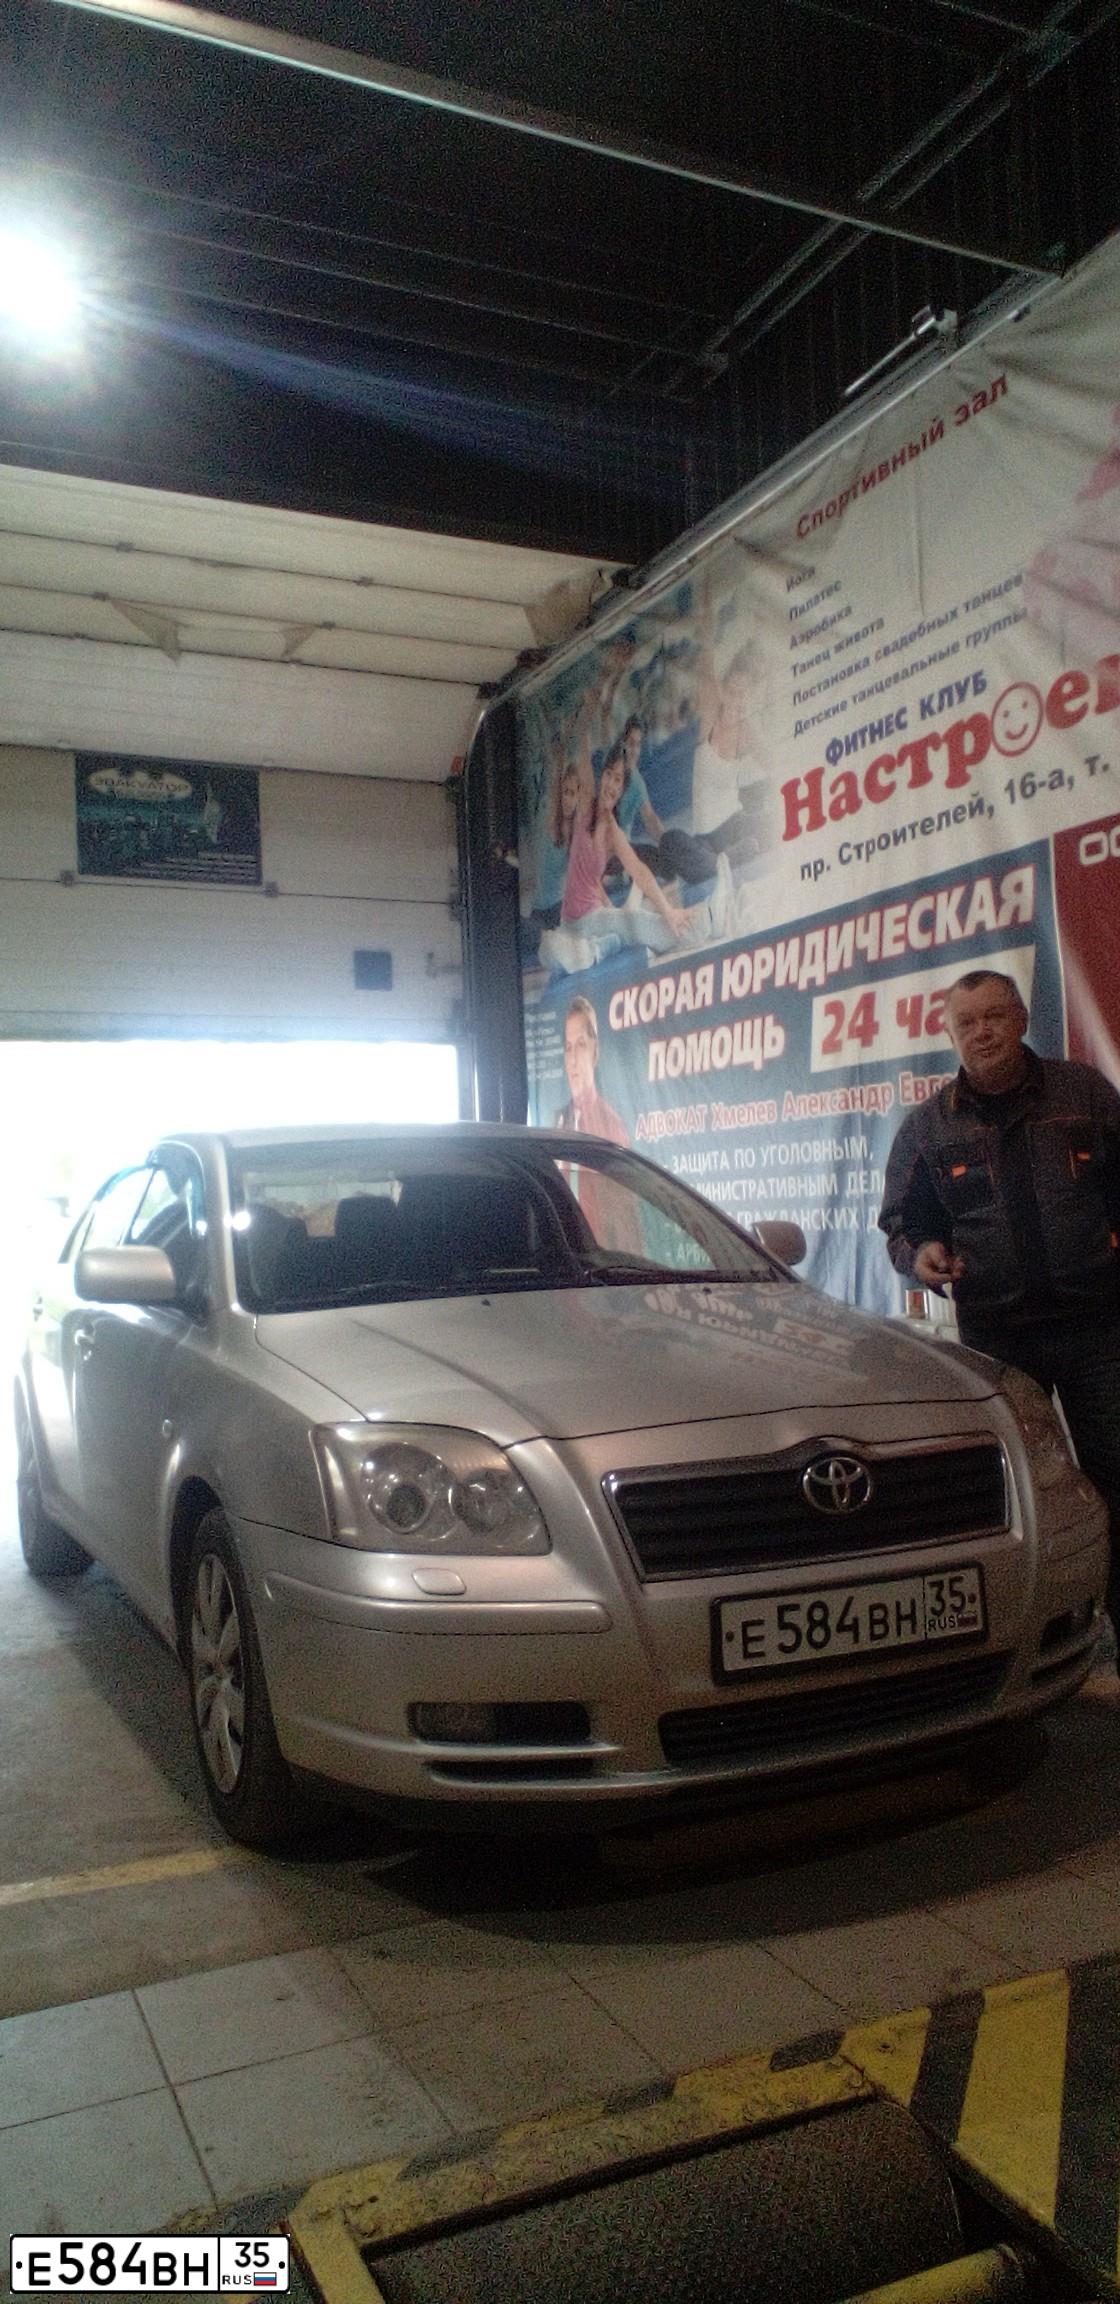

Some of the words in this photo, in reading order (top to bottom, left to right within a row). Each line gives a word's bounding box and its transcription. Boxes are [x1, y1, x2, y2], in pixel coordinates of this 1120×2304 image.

[796, 416, 946, 540] Спортивный
[954, 373, 1009, 428] зал
[789, 580, 843, 622] Пилатес
[789, 605, 852, 650] Аэробика
[791, 648, 831, 678] Танец
[834, 617, 885, 655] живота
[792, 656, 870, 707] Постановка
[874, 607, 959, 663] свадебных
[963, 572, 1024, 614] танцев
[793, 699, 848, 738] Детские
[852, 640, 960, 705] танцевальные
[965, 606, 1029, 648] группы
[825, 706, 908, 767] ФИТНЕС
[919, 669, 988, 721] КЛУБ
[800, 860, 831, 882] пр.
[838, 792, 995, 866] Строителей,
[1003, 768, 1075, 805] 16-а,
[1084, 753, 1111, 778] т.
[608, 963, 715, 1032] СКОРАЯ
[721, 864, 1036, 1003] ЮРИДИЧЕСКАЯ
[647, 1013, 787, 1083] ПОМОЩЬ
[820, 990, 881, 1057] 24
[895, 988, 950, 1040] ча
[635, 1105, 707, 1141] АДВОКАТ
[711, 1099, 777, 1130] Хмелев
[781, 1082, 894, 1120] Александр
[898, 1071, 957, 1107] Евге
[671, 1151, 730, 1175] ЗАЩИТА
[734, 1147, 756, 1169] ПО
[760, 1134, 873, 1165] УГОЛОВНЫМ,
[690, 1172, 838, 1201] МИНИСТРАТИВНЫМ
[846, 1167, 884, 1198] ДЕЛ
[741, 1596, 917, 1659] Е584ВН
[927, 1575, 968, 1617] 35
[927, 1615, 957, 1633] RUS
